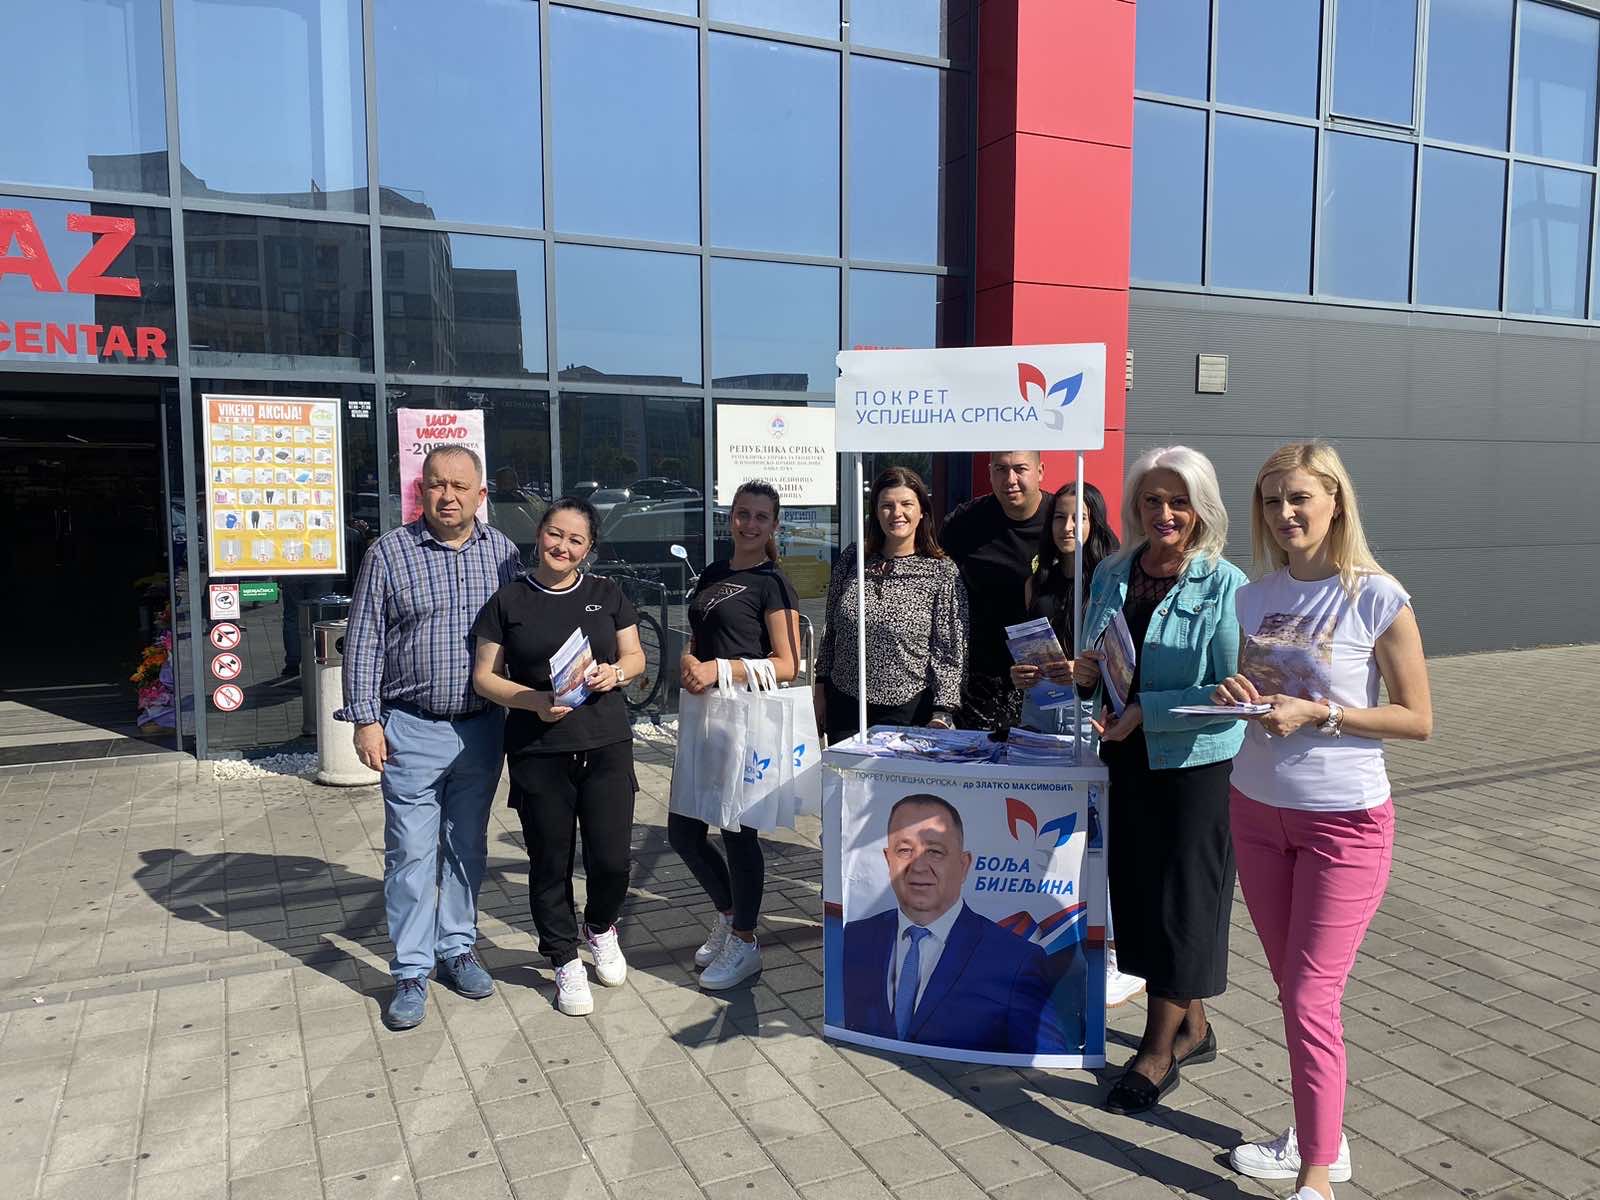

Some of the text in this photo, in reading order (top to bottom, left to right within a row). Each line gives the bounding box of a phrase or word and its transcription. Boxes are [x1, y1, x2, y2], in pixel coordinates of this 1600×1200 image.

[855, 389, 949, 406] ПОКРЕТ
[218, 402, 255, 417] VIKEND
[258, 404, 303, 420] AKCIJA!
[855, 406, 1039, 425] УСПЈЕШНА СРПСКА
[415, 427, 468, 439] VIKEND
[729, 444, 826, 455] РЕПУБЛИКА СРПСКА
[855, 771, 884, 782] ПОКРЕТ
[885, 774, 926, 785] УСПЈЕШНА
[926, 777, 957, 787] СРПСКА
[975, 780, 1010, 790] ЗЛАТКО
[1012, 782, 1074, 792] МАКСИМОВИЋ
[974, 856, 1031, 873] БОЉА
[974, 876, 1074, 895] БИЈЕЉИНА
